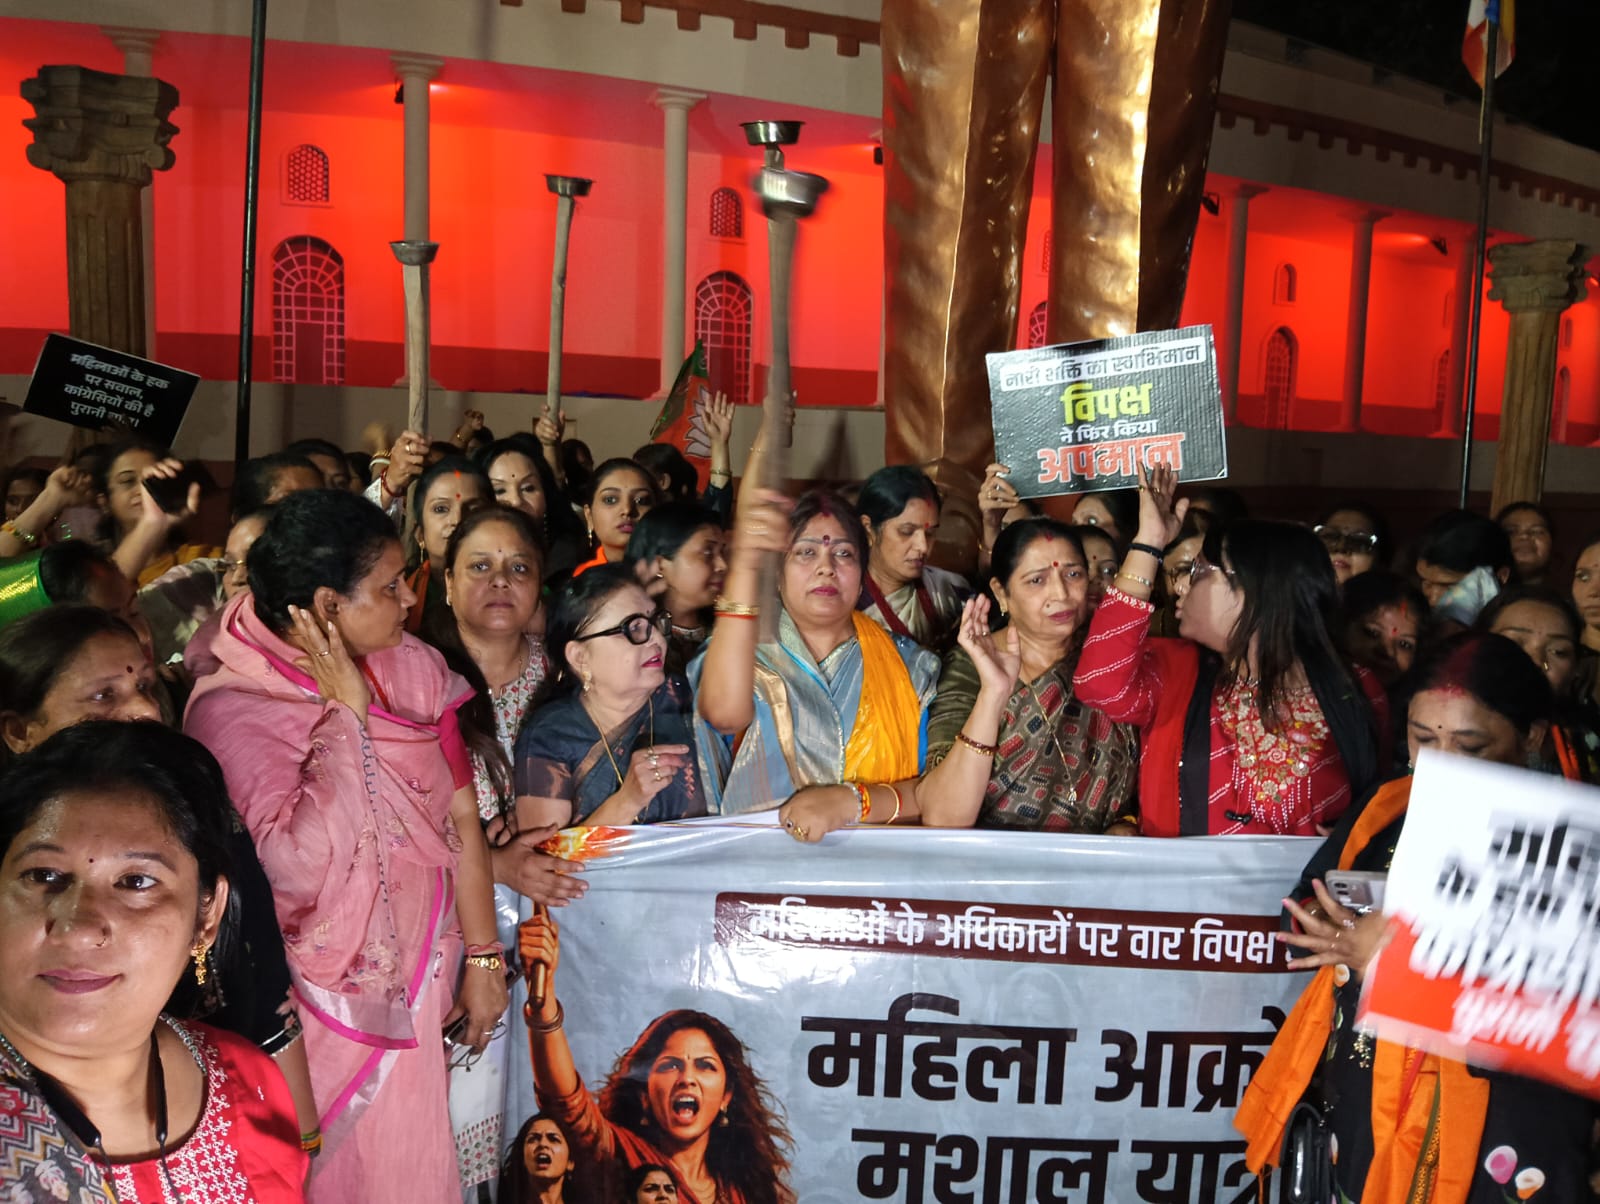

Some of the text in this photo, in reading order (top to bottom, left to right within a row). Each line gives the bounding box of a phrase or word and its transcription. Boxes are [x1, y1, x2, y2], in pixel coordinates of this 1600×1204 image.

[70, 353, 171, 390] महिलाओं के हक
[84, 373, 102, 387] पर
[1045, 359, 1082, 380] शक्ति
[1086, 358, 1108, 376] का
[1111, 344, 1201, 373] स्वाभिमान
[70, 401, 106, 419] पुरानी
[124, 399, 143, 414] की
[143, 402, 155, 418] है
[1060, 382, 1153, 425] विपक्ष
[1060, 419, 1158, 443] ने फिर किया
[1038, 432, 1186, 484] अपमान
[894, 902, 928, 946] के
[935, 906, 1074, 955] अधिकारों
[1076, 921, 1122, 957] पर
[1127, 924, 1185, 960] वार
[1190, 917, 1277, 965] विपक्ष
[801, 992, 1078, 1105] महिला
[851, 1128, 1119, 1204] मशाल
